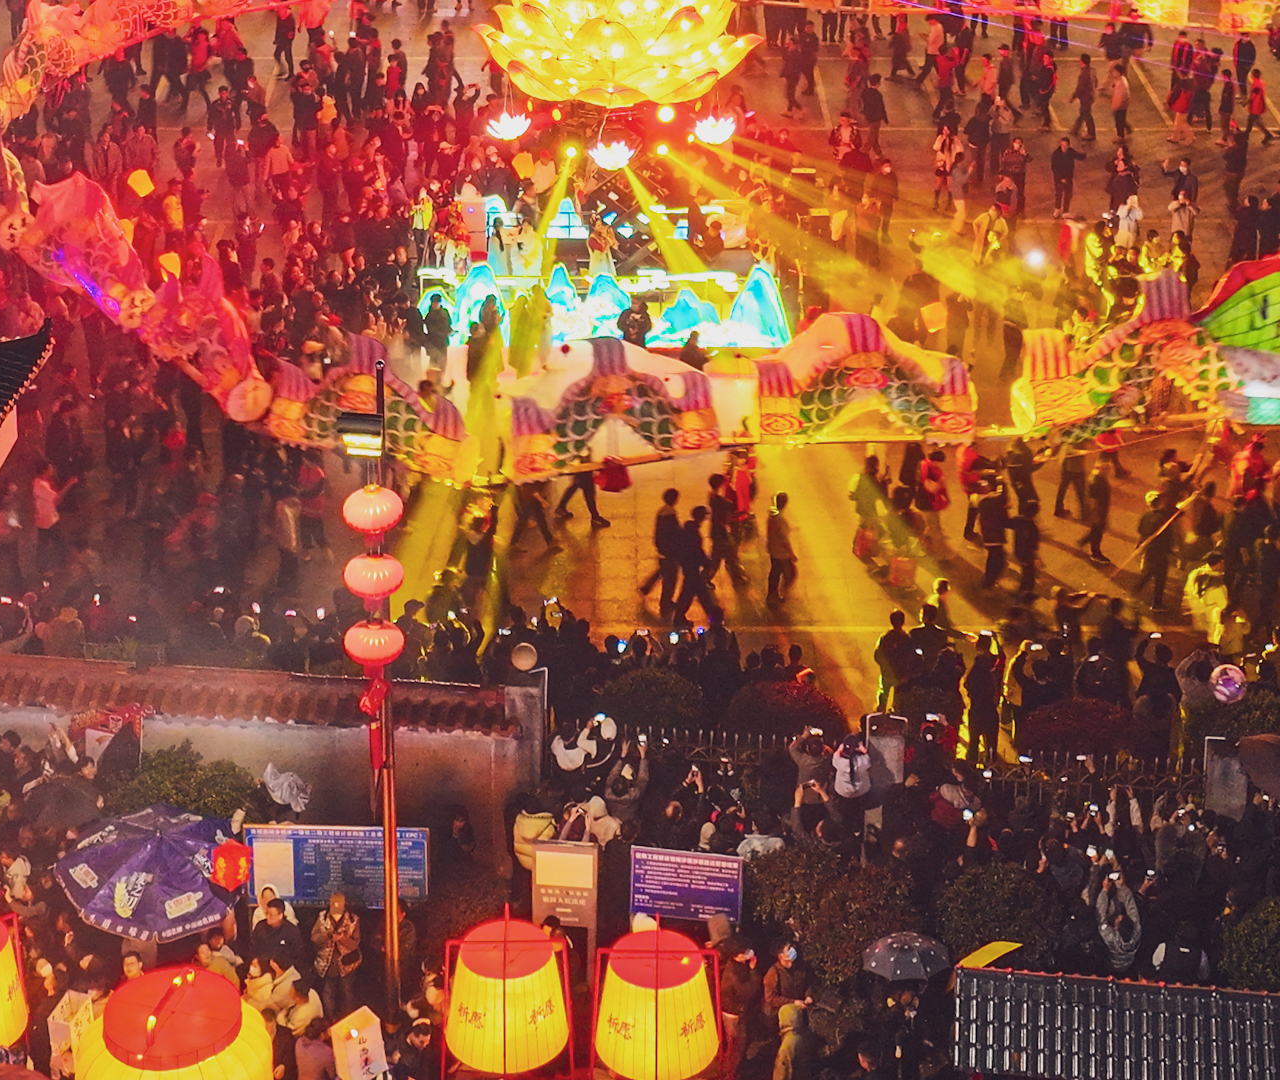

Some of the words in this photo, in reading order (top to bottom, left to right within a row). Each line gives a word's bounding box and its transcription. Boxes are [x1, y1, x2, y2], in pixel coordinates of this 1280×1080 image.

[458, 1002, 486, 1029] 祈愿
[528, 996, 555, 1026] 祈愿
[680, 1010, 706, 1038] 祈愿
[607, 1014, 635, 1040] 祈愿
